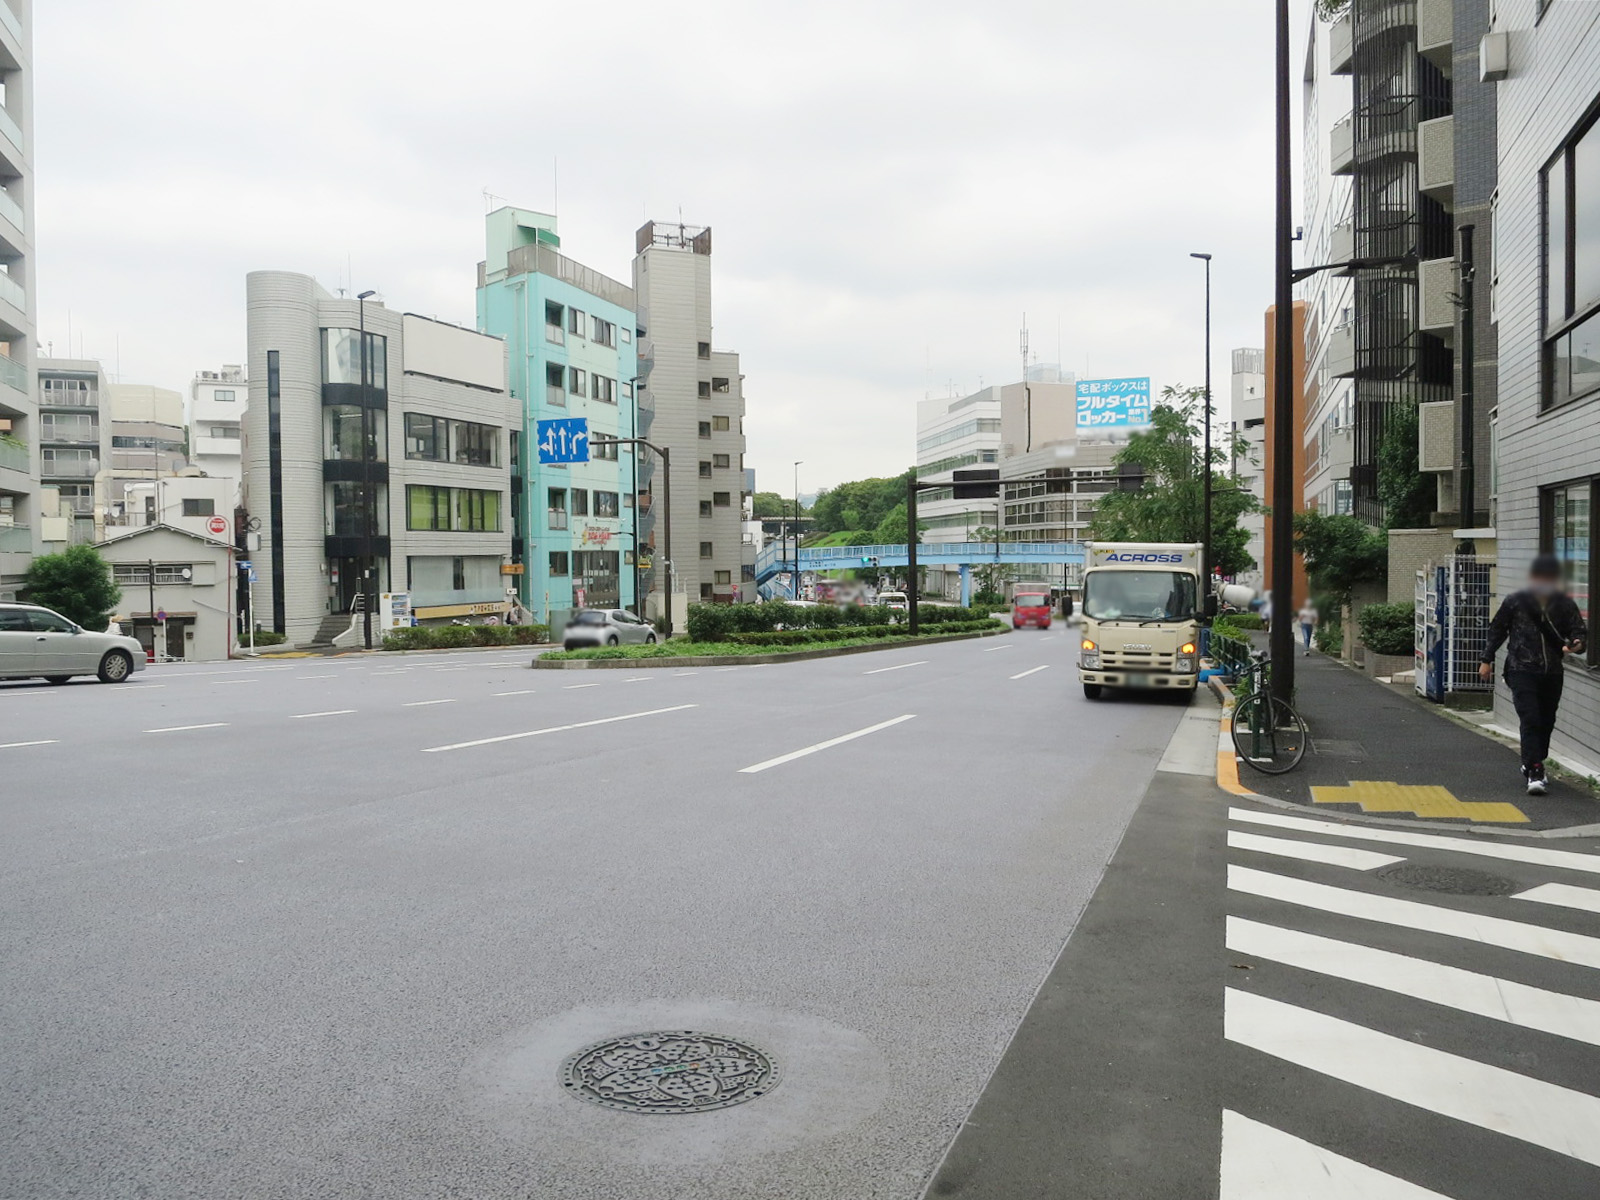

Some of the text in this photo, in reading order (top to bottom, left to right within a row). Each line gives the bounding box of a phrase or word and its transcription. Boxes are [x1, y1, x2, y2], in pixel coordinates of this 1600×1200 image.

[1078, 381, 1147, 393] 宅配ボックスは
[1077, 394, 1148, 409] フルタイム
[1077, 410, 1126, 425] ロッカー
[1106, 554, 1182, 563] ACROSS
